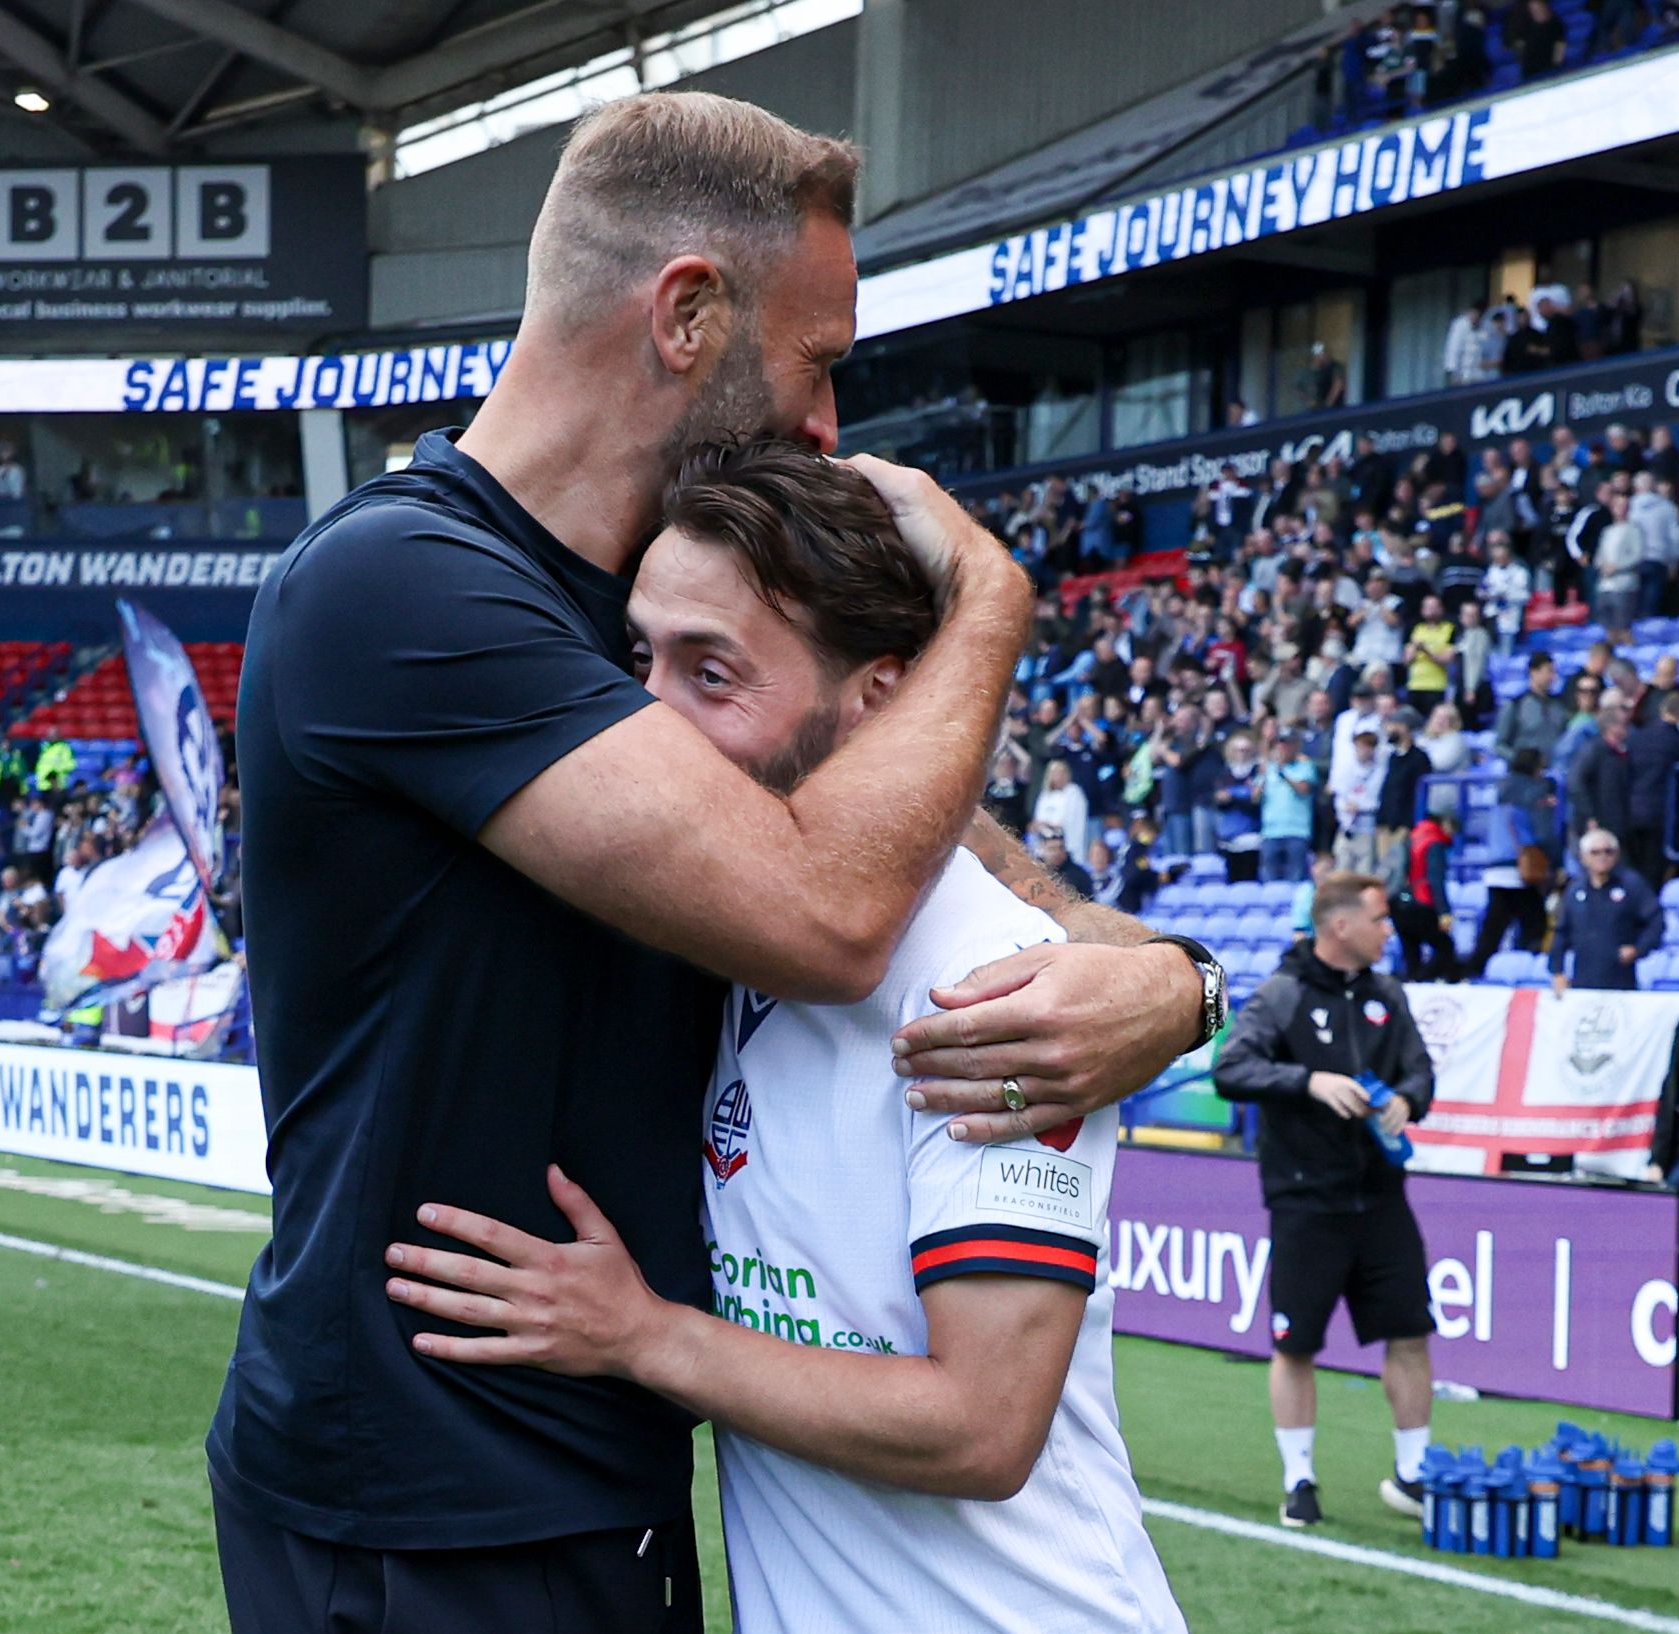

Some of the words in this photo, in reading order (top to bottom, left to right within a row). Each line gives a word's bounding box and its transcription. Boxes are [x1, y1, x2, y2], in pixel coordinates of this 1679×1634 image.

[8, 181, 248, 243] B2B
[989, 218, 1098, 305] SAFE
[1098, 153, 1320, 276] JOURNEY
[1333, 109, 1490, 216] HOME
[35, 298, 128, 319] business
[132, 297, 236, 318] workwear
[122, 359, 264, 411] SAFE
[1470, 391, 1556, 440] KIA
[0, 1062, 210, 1158] WANDERERS
[1000, 1158, 1080, 1198] whites
[994, 1194, 1081, 1219] BEACONSFIELD
[1108, 1219, 1271, 1333] uxury
